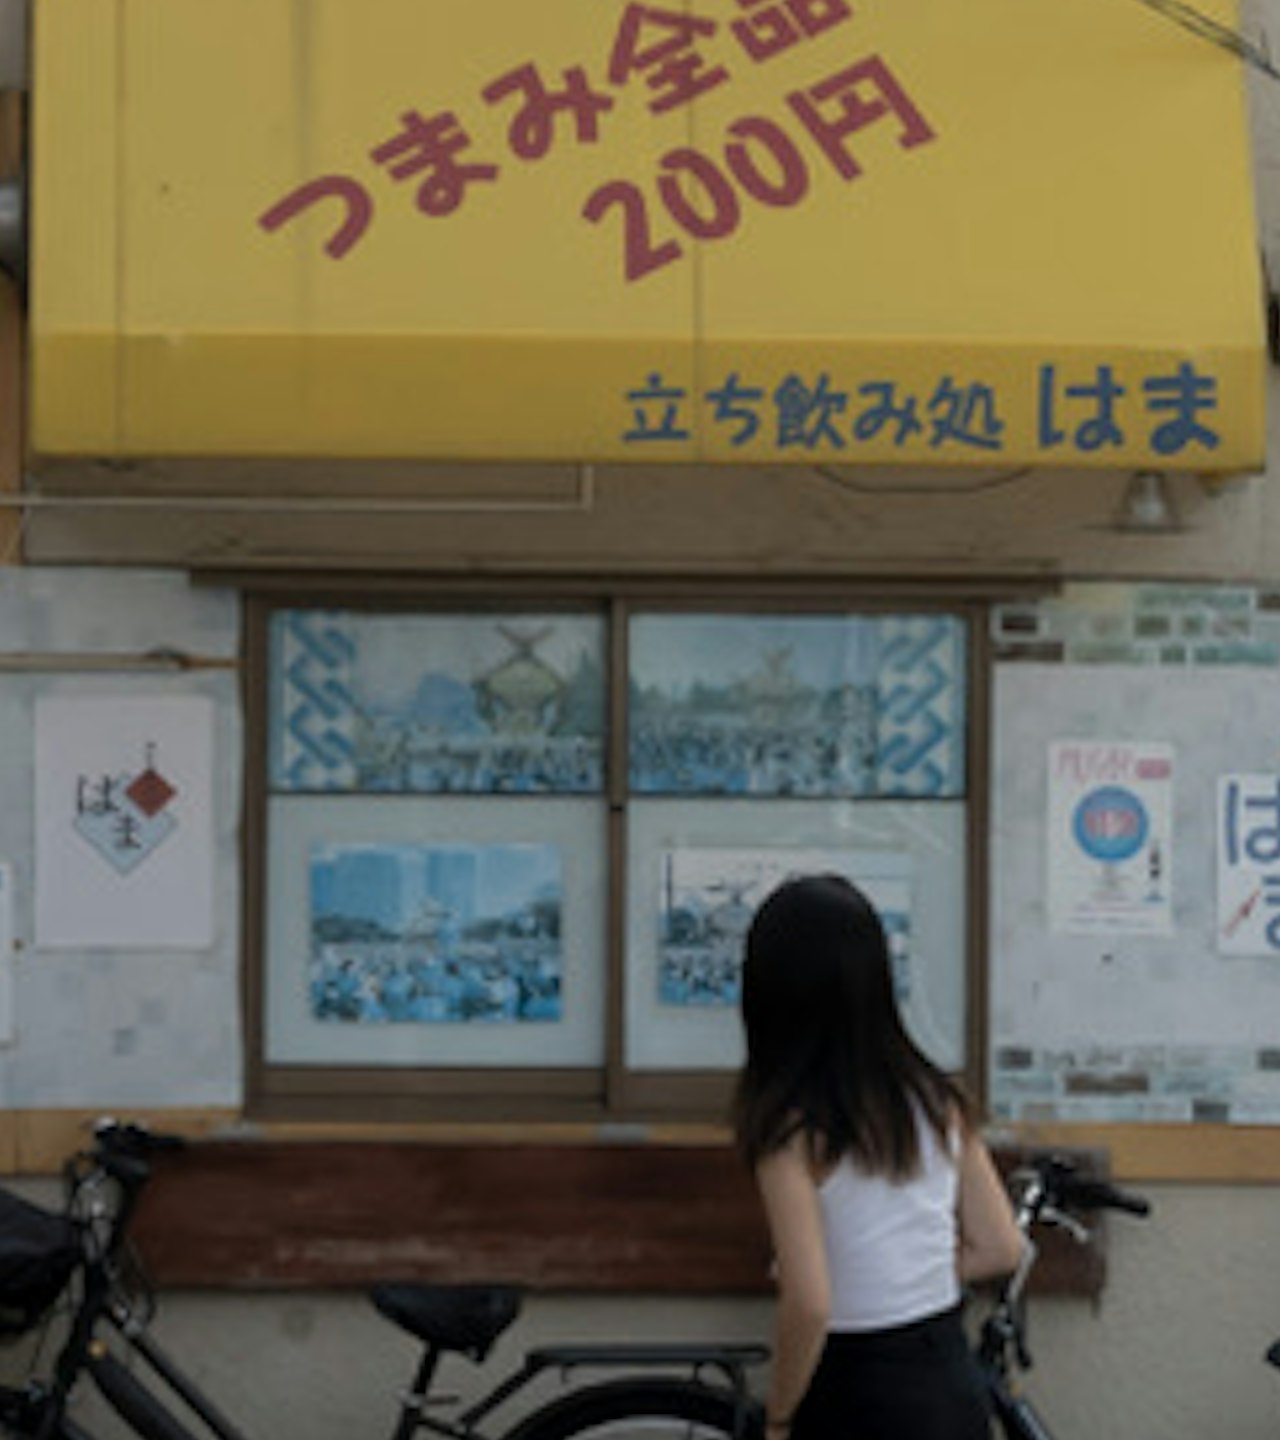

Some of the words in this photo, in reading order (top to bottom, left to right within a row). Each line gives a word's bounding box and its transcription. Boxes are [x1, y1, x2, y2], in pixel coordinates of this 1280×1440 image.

[581, 52, 937, 283] 200円
[621, 370, 1003, 453] 立ち飲み処
[1039, 362, 1222, 455] はま
